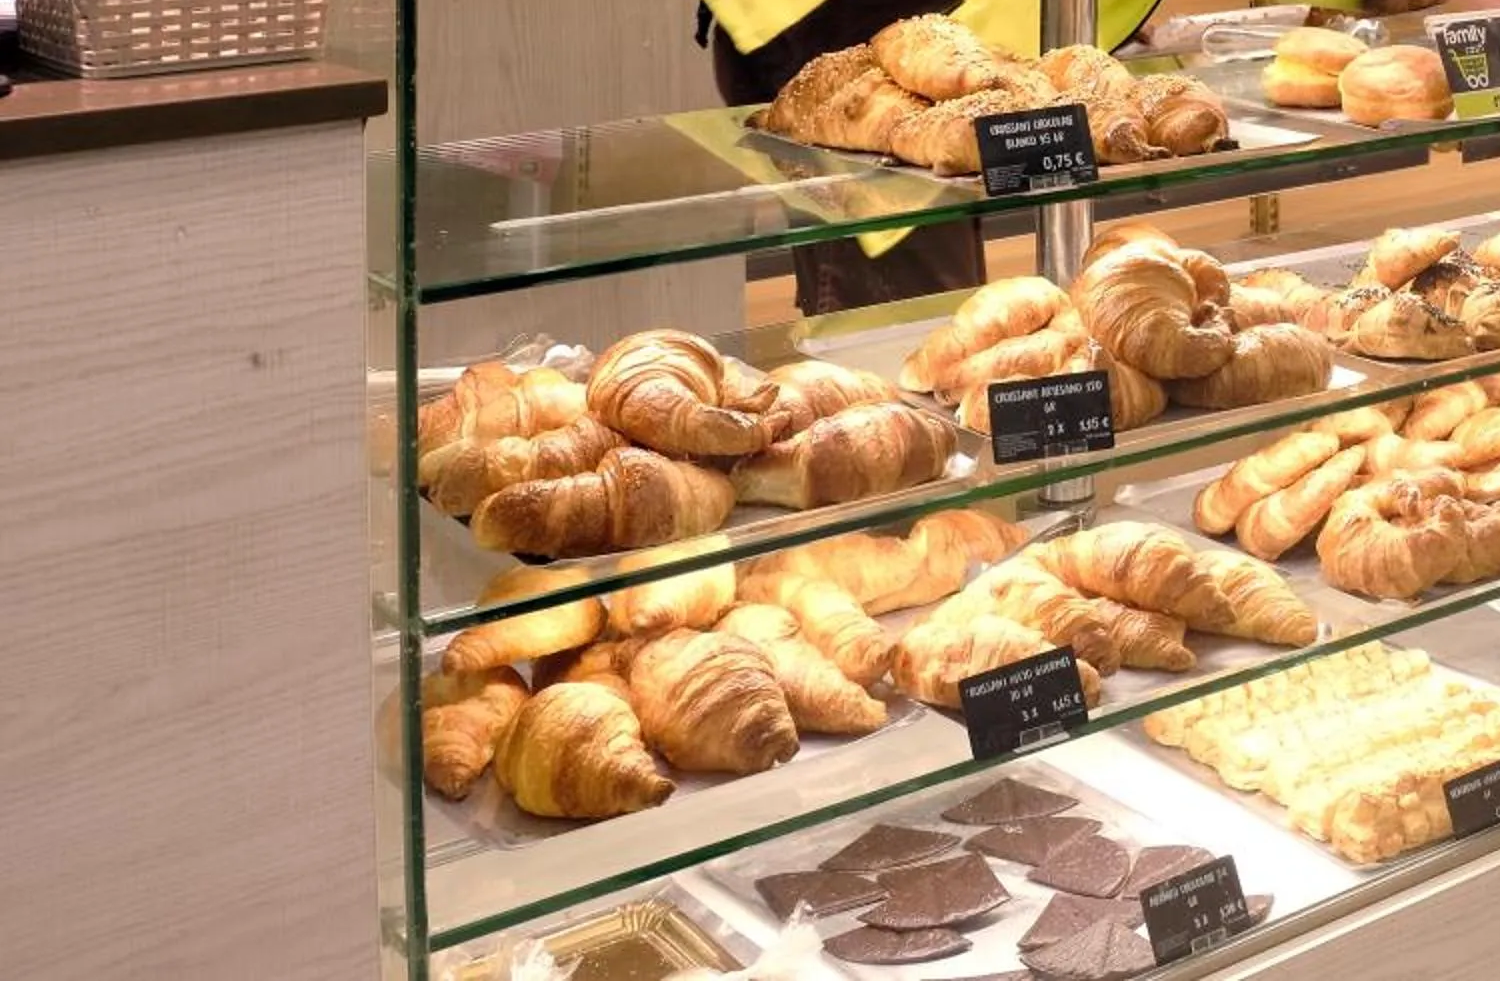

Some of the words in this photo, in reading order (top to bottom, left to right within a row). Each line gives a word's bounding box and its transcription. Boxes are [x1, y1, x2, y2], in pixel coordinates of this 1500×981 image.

[1443, 24, 1487, 45] family
[1043, 153, 1073, 171] 0,75
[1075, 152, 1085, 165] €
